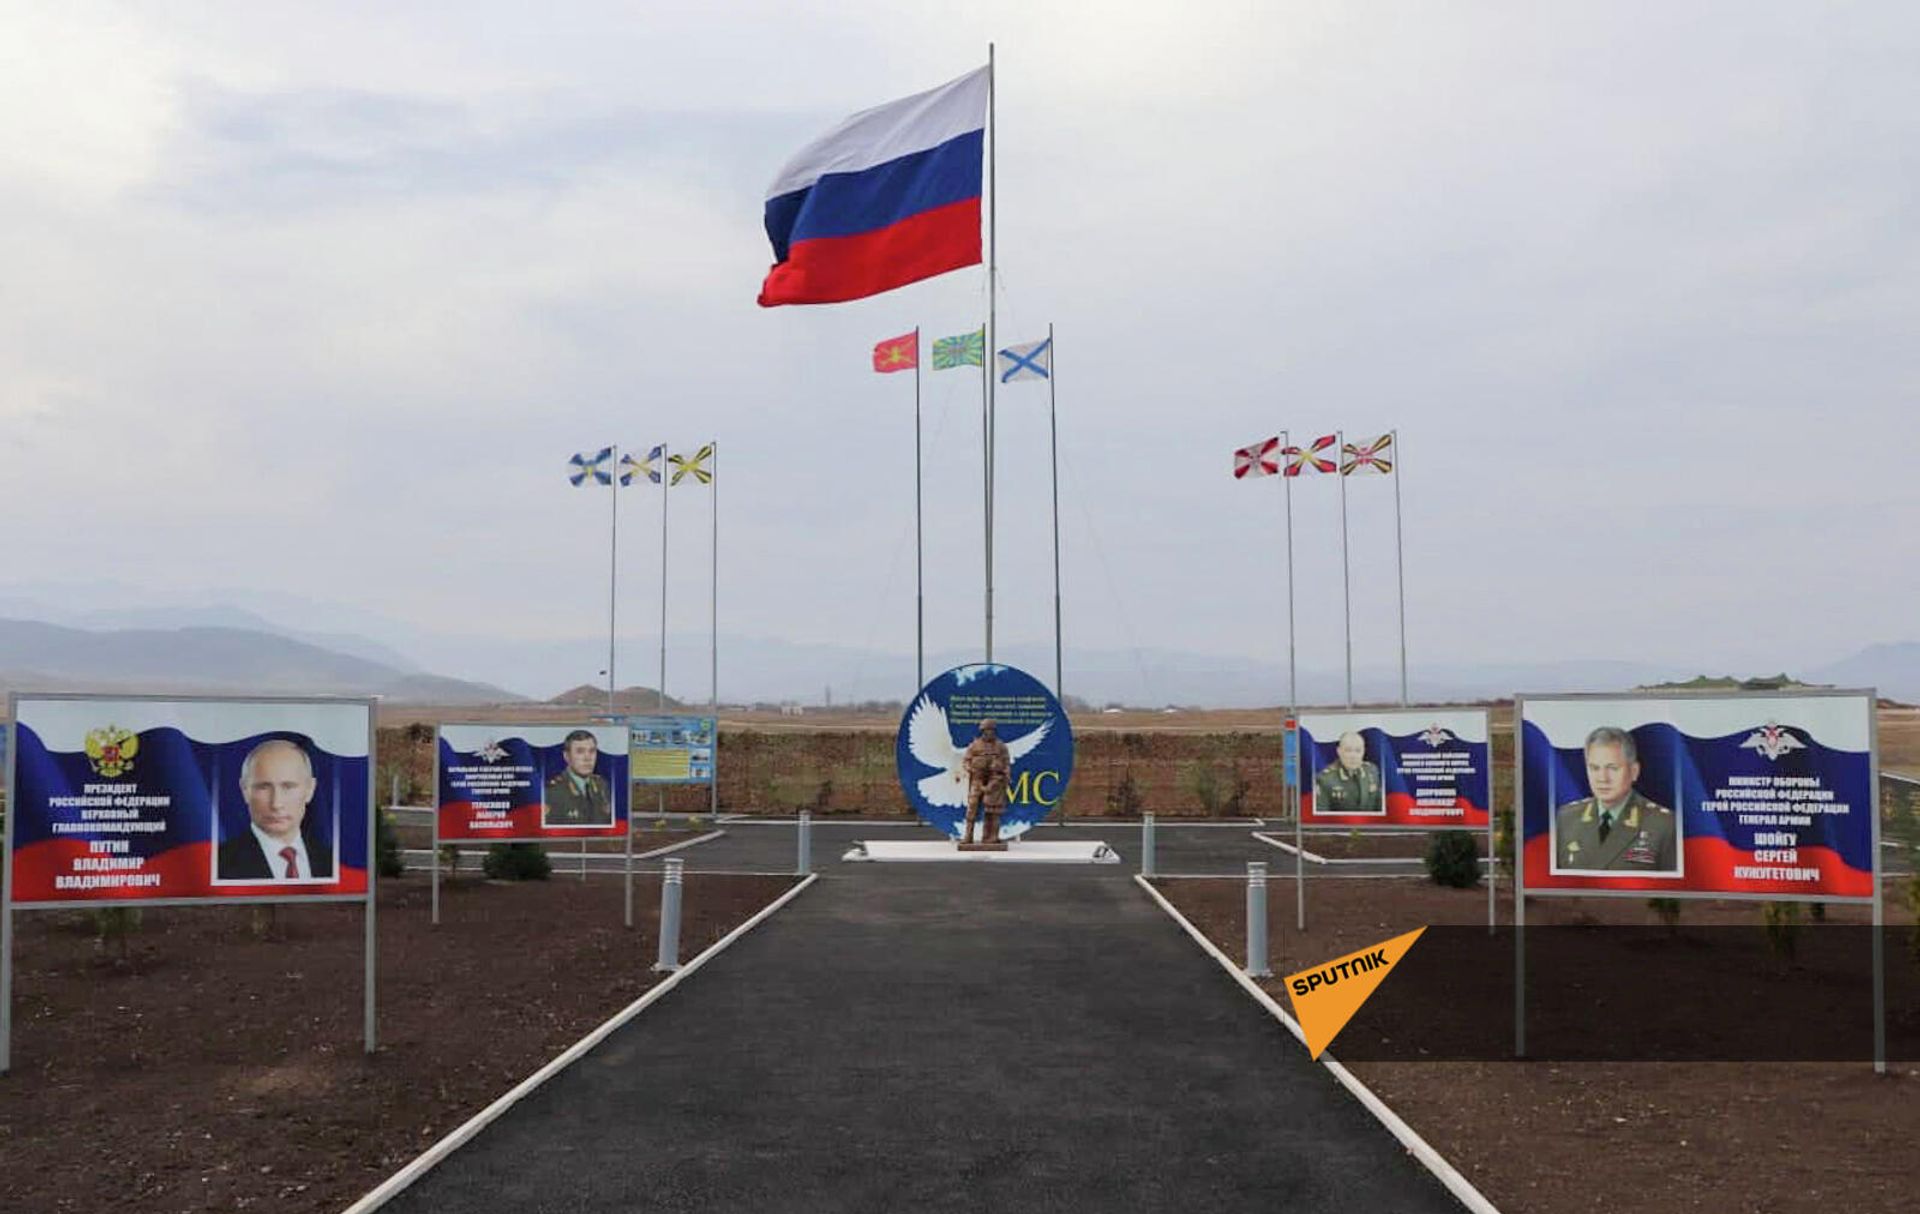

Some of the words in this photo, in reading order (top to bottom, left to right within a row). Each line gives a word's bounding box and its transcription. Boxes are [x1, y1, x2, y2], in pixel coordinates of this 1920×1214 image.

[84, 783, 137, 793] ПРЕЗИДЕНТ
[1715, 787, 1776, 799] РОССИЙСКОЙ
[1777, 789, 1834, 801] ФЕДЕРАЦИИ
[49, 795, 112, 807] РОССИЙСКОЙ
[114, 796, 170, 807] ФЕДЕРАЦИИ
[1702, 800, 1729, 812] ГЕРОЙ
[1730, 801, 1791, 812] РОССИЙСКОЙ
[1792, 803, 1849, 814] ФЕДЕРАЦИИ
[81, 809, 139, 819] ВЕРХОВНЫЙ
[1739, 814, 1777, 825] ГЕНЕРАЛ
[52, 820, 166, 833] ГЛАВНОКОМАНДУЮЩИЙ
[1754, 832, 1797, 846] ШОЙГУ
[90, 840, 129, 853] ПУТИН
[1754, 849, 1797, 863] СЕРГЕЙ
[73, 857, 144, 870] ВЛАДИМИР
[1734, 866, 1820, 881] КУЖУГЕТОВИЧ
[55, 874, 160, 889] ВЛАДИМИРОВИЧ
